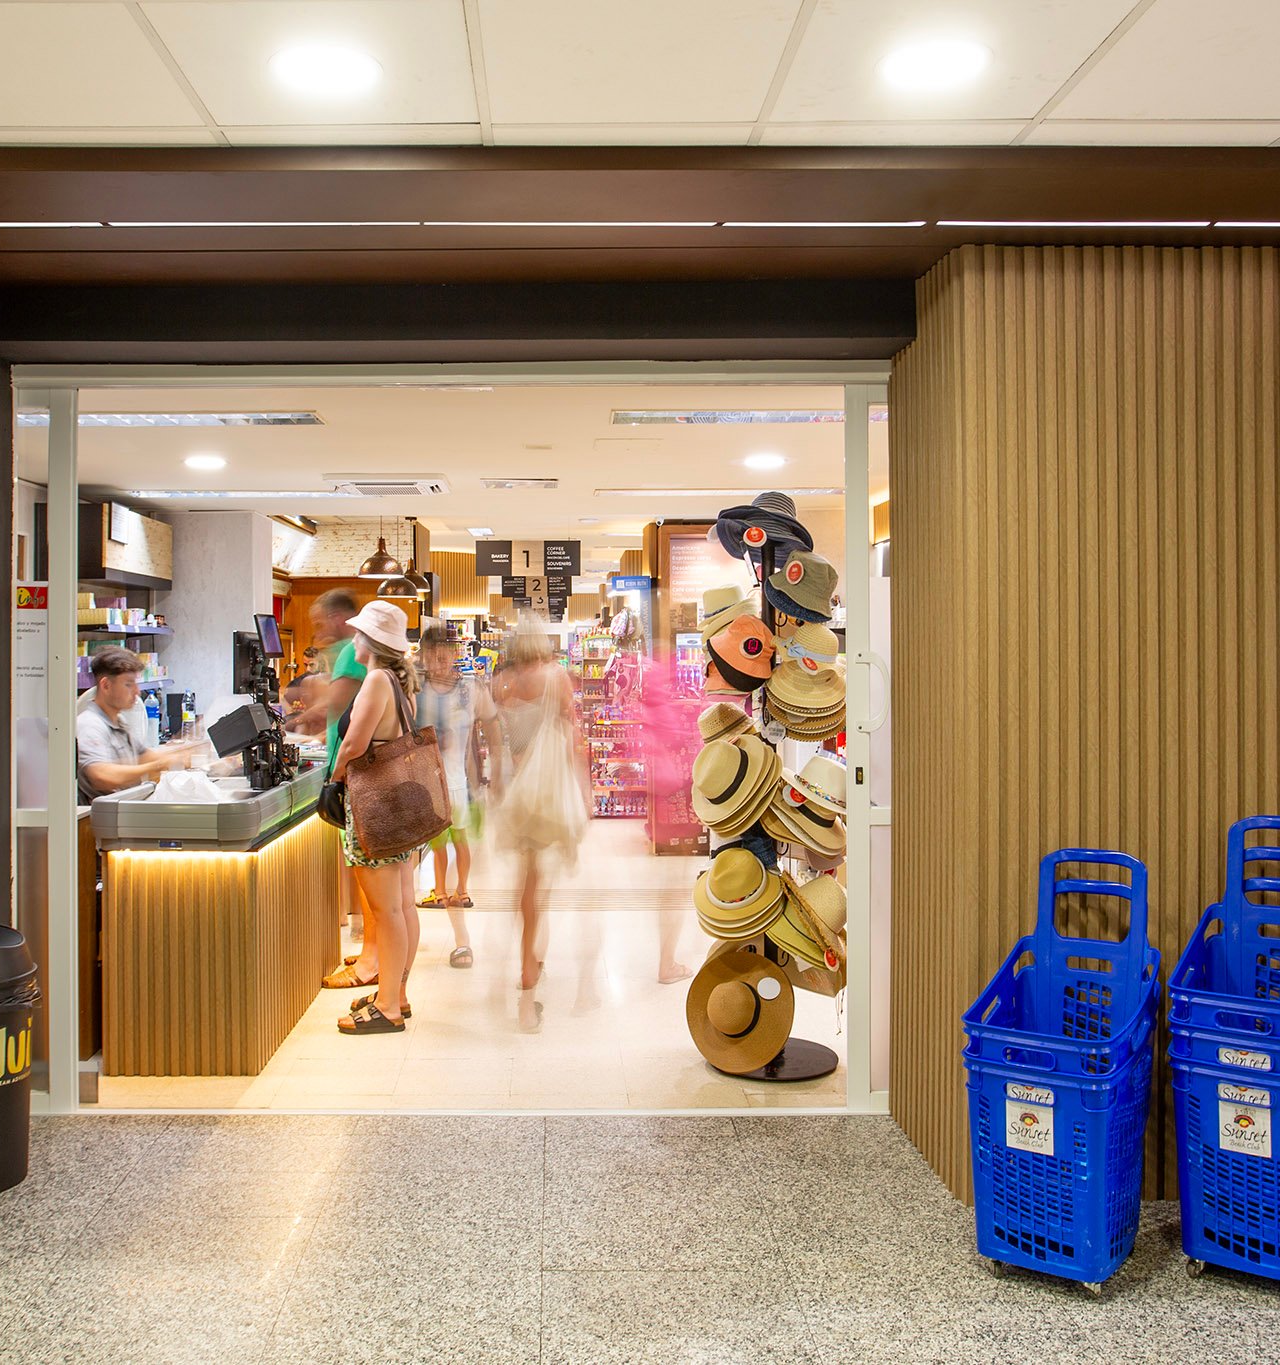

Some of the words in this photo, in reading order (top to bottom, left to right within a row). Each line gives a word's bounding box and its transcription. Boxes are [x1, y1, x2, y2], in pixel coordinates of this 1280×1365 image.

[522, 550, 530, 568] 1
[532, 579, 541, 591] 2
[1008, 1121, 1051, 1142] Sunset
[1221, 1123, 1268, 1144] Sunset
